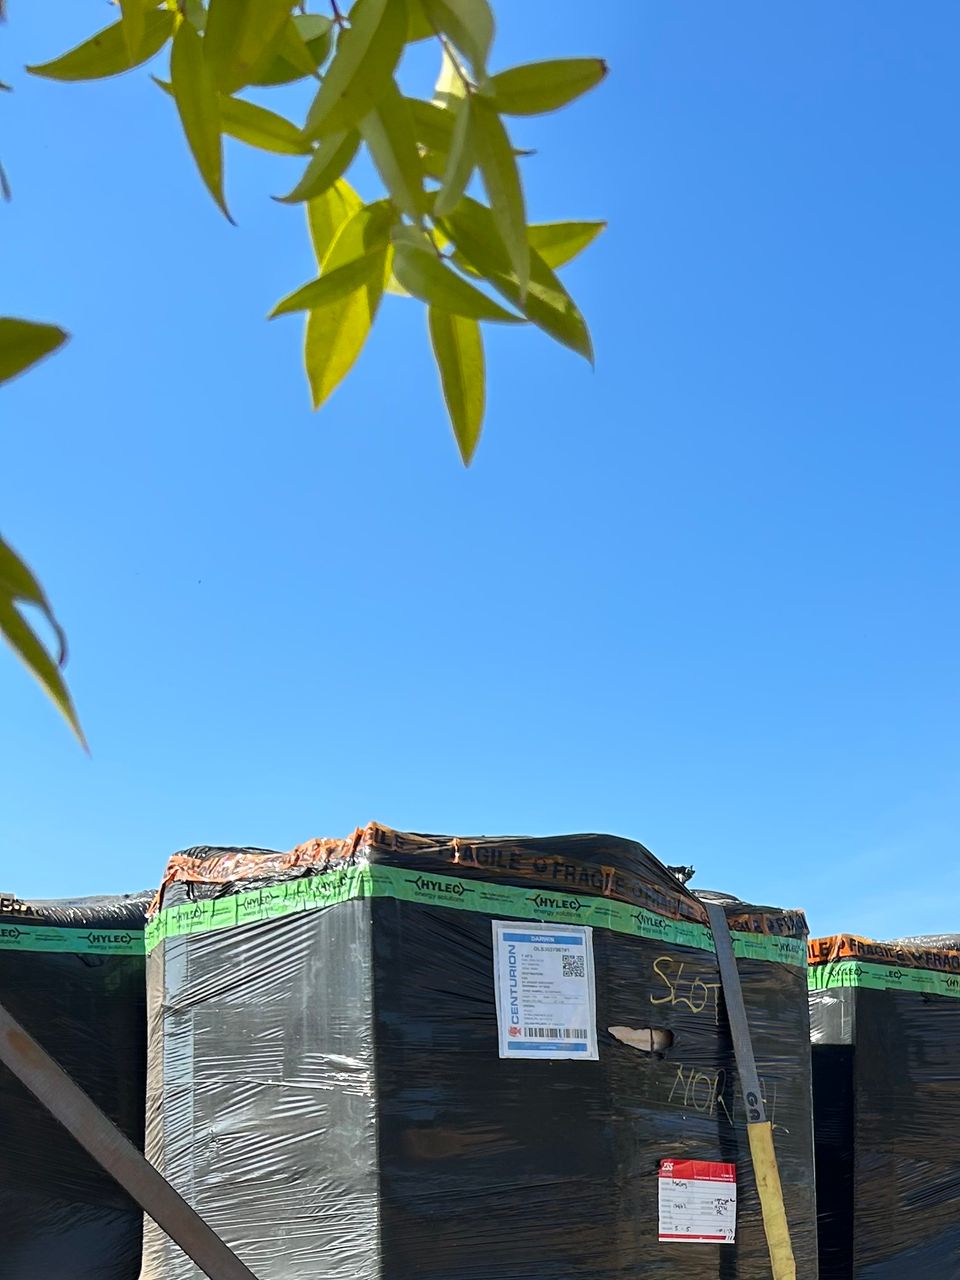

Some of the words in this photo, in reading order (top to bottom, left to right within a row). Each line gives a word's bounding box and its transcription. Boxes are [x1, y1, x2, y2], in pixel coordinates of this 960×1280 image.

[421, 880, 460, 895] HYLEC
[540, 898, 577, 910] HYLEC
[641, 915, 665, 928] HYLEC
[92, 934, 127, 944] HYLEC
[508, 945, 519, 1024] CENTURION
